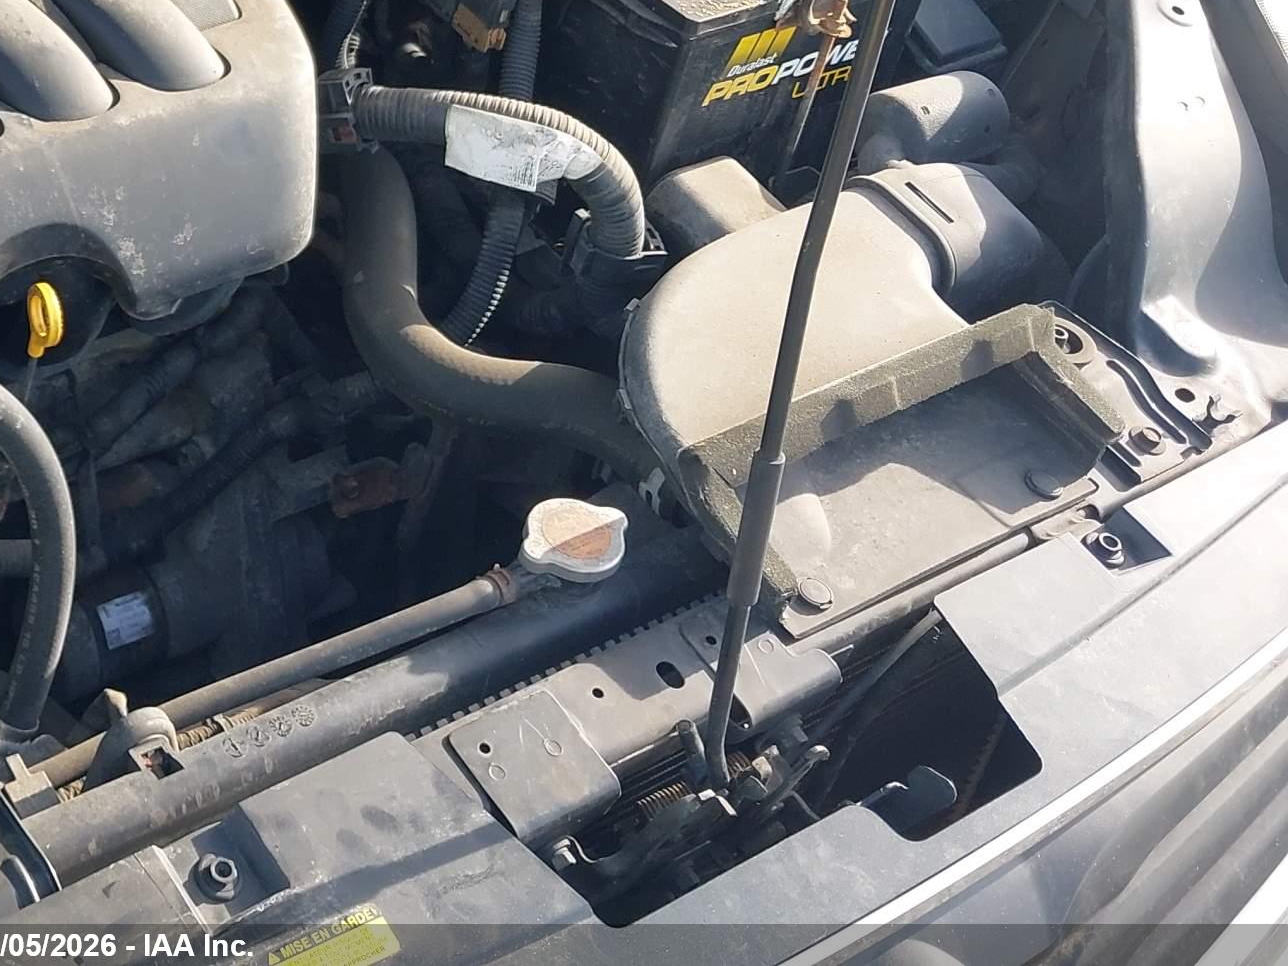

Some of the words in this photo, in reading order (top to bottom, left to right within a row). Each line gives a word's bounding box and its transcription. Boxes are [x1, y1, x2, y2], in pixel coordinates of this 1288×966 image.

[701, 39, 860, 107] PROPOWE
[727, 52, 778, 78] Duralast
[280, 937, 312, 959] MISE
[312, 928, 330, 944] EN
